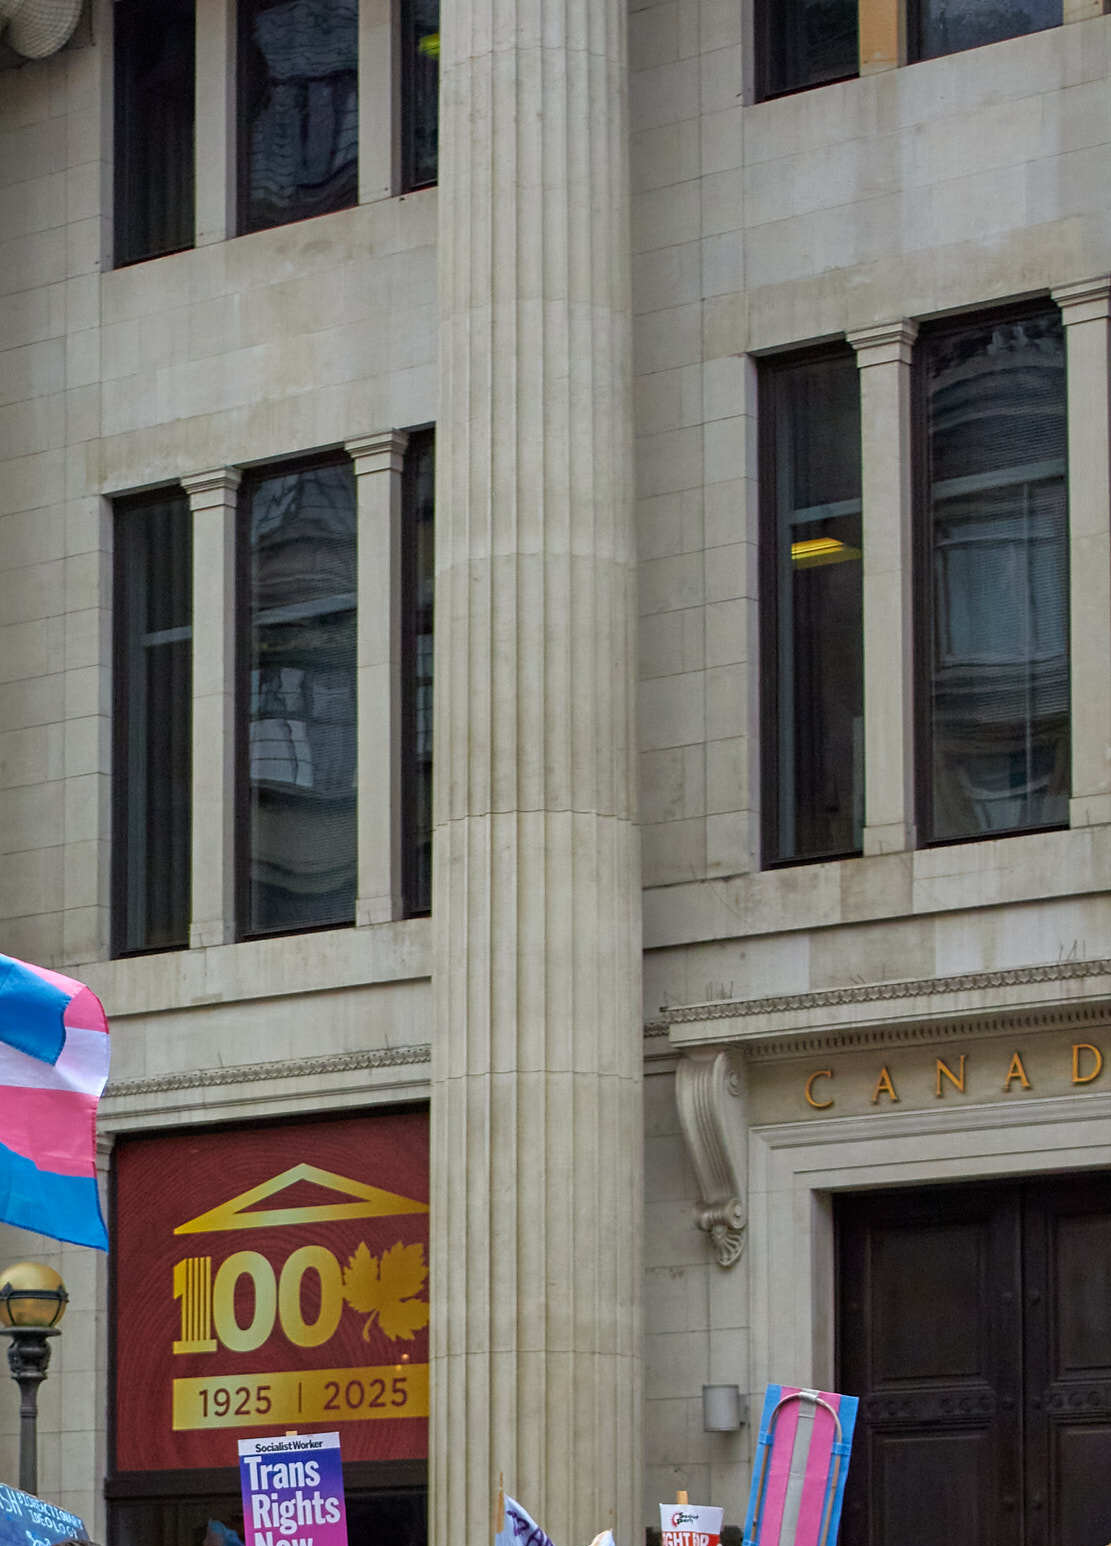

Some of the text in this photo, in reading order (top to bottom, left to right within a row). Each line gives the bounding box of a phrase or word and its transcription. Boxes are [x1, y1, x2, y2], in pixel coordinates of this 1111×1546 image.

[172, 1245, 344, 1355] 100
[198, 1377, 409, 1418] 1925 2025
[255, 1439, 324, 1453] Socialist Worker
[244, 1456, 321, 1491] Trans
[251, 1490, 341, 1535] Rights
